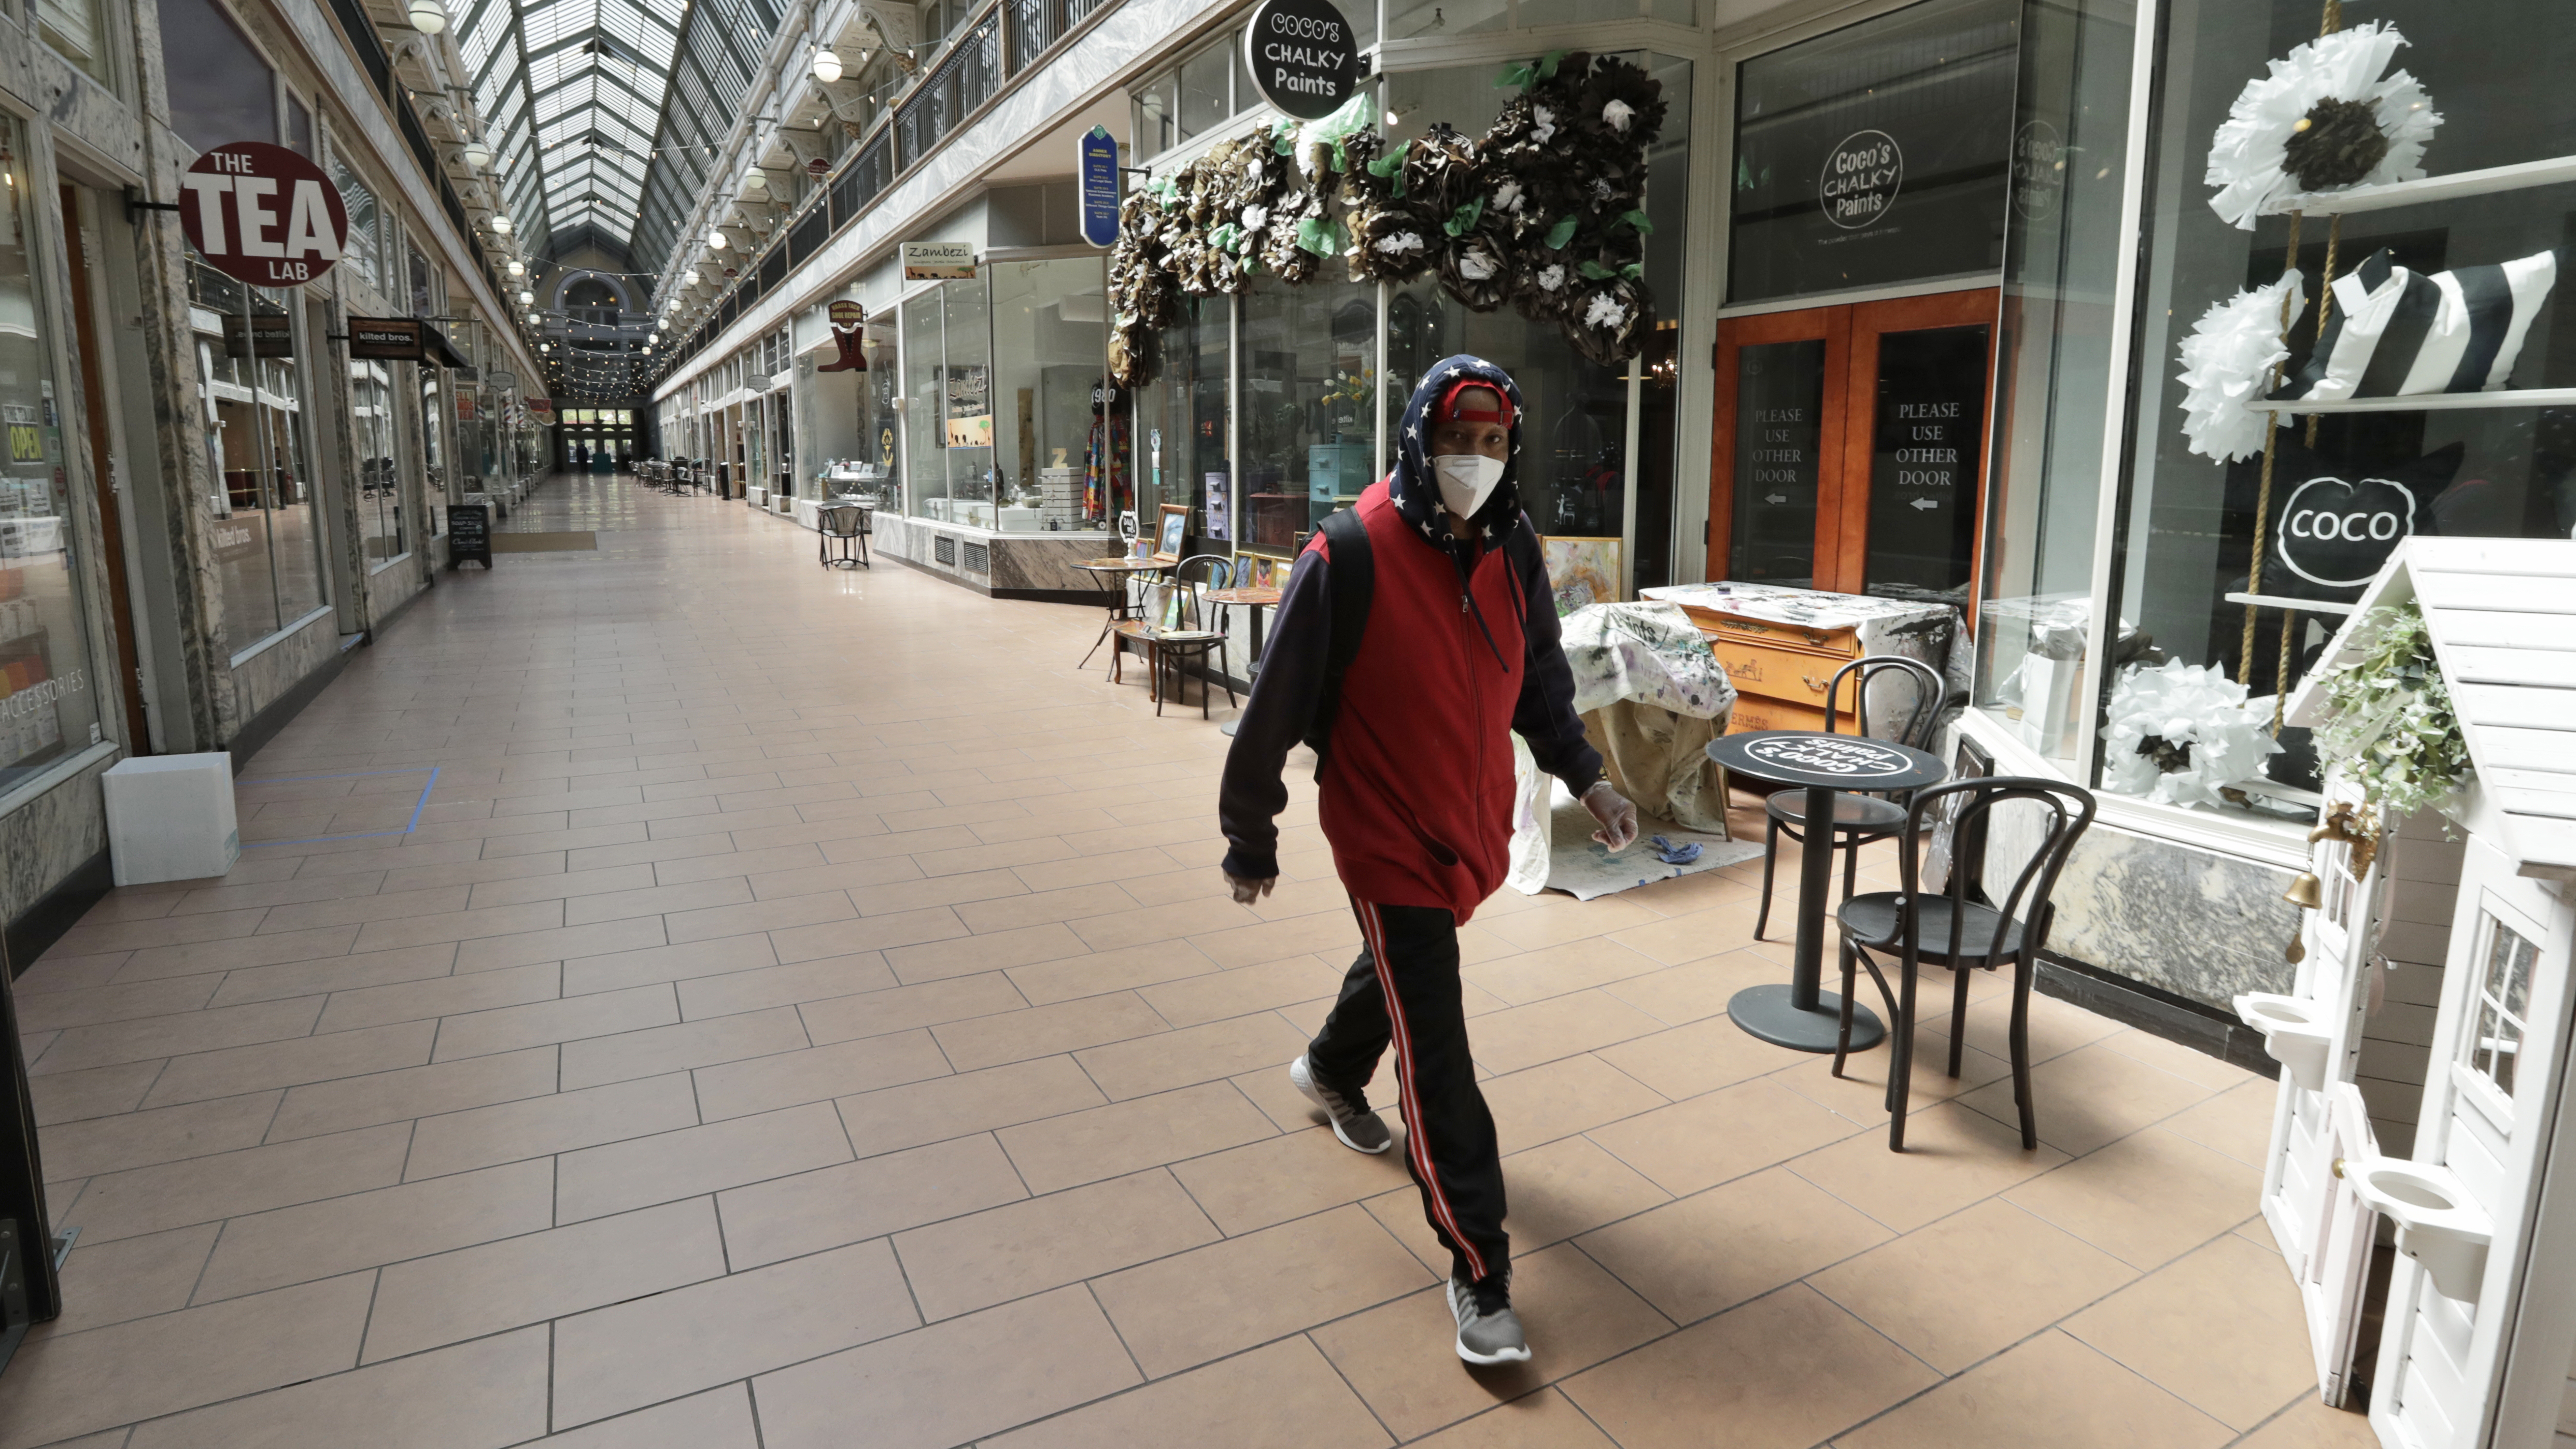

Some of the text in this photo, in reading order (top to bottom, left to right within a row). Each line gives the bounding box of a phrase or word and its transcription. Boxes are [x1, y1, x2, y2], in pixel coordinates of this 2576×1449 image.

[1271, 13, 1339, 42] COCO'S
[1265, 43, 1346, 69] CHALKY
[1276, 68, 1336, 96] Paints
[210, 152, 254, 174] THE
[1824, 165, 1898, 196] CHALKY
[1836, 191, 1883, 219] Paints
[183, 172, 343, 261] TEA
[909, 245, 968, 257] Zambezi
[268, 261, 309, 280] LAB
[359, 332, 413, 342] kilted bros.
[1756, 409, 1803, 423] PLEASE
[1899, 402, 1960, 418] PLEASE
[10, 426, 43, 459] OPEN
[1765, 429, 1790, 443] USE
[1912, 426, 1943, 441] USE
[1753, 449, 1801, 462] OTHER
[1895, 448, 1957, 463] OTHER
[1756, 469, 1796, 483] DOOR
[1898, 470, 1951, 485] DOOR
[2291, 509, 2398, 542] COCO
[1, 669, 84, 723] ACCESSORIES
[1731, 712, 1769, 731] ERMÈS
[1761, 741, 1898, 770] CHALKY
[1805, 739, 1895, 761] Paints
